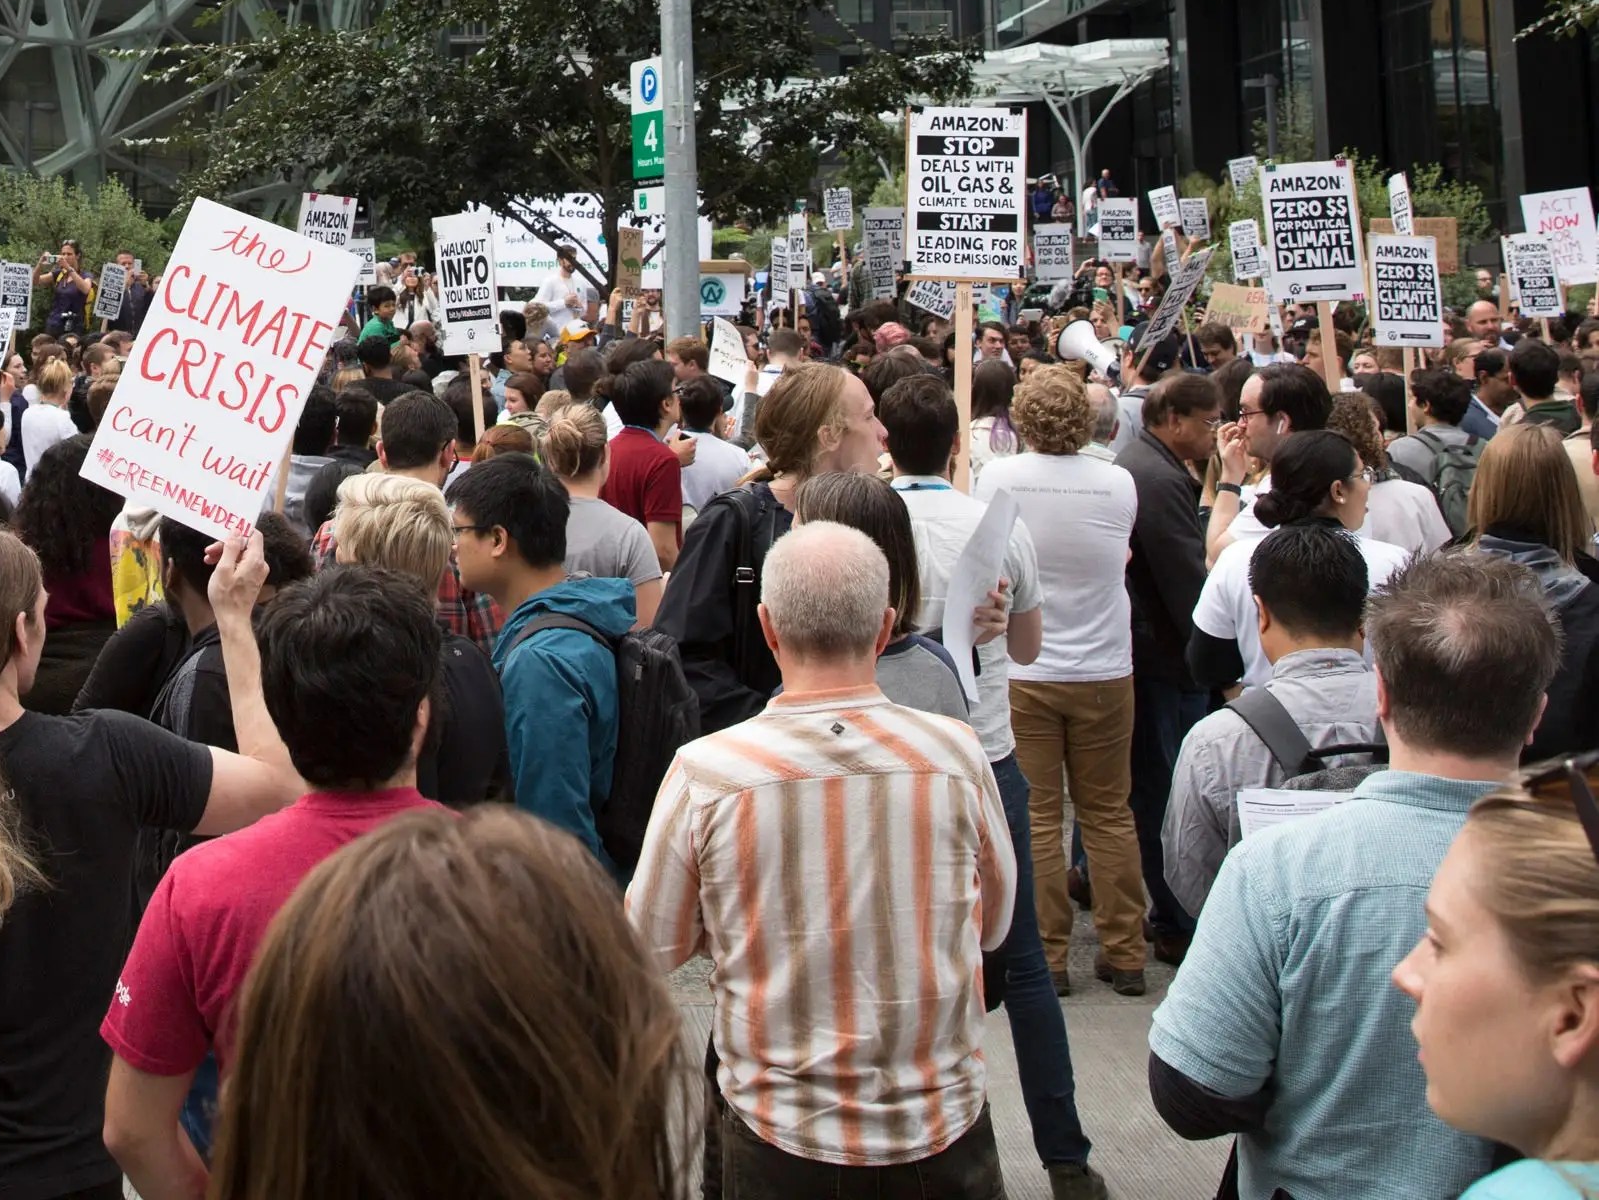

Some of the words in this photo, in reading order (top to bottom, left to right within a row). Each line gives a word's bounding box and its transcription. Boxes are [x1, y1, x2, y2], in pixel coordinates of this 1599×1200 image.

[644, 75, 655, 97] P
[930, 116, 1008, 131] AMAZON:
[644, 120, 658, 151] 4
[943, 137, 994, 155] STOP
[638, 158, 653, 168] Hours
[654, 157, 664, 165] Ma
[921, 159, 970, 172] DEALS
[976, 161, 1014, 173] WITH
[922, 176, 956, 195] OIL,
[958, 177, 994, 193] GAS
[999, 177, 1013, 194] &
[1270, 176, 1345, 192] AMAZON:
[919, 197, 967, 207] CLIMATE
[974, 198, 1015, 208] DENIAL
[1272, 200, 1322, 218] ZERO
[1326, 197, 1347, 217] $$
[1540, 197, 1576, 214] ACT
[867, 220, 880, 229] NO
[881, 220, 901, 229] AWS
[940, 214, 994, 230] START
[1274, 221, 1294, 231] FOR
[1295, 218, 1349, 230] POLITICAL
[1540, 213, 1579, 231] NOW
[325, 231, 346, 245] LEAD
[918, 236, 983, 251] LEADING
[991, 239, 1017, 250] FOR
[1050, 236, 1068, 244] AWS
[1276, 229, 1352, 249] CLIMATE
[1554, 230, 1572, 241] OR
[209, 225, 311, 274] the
[440, 239, 486, 257] WALKOUT
[1039, 248, 1053, 256] FOR
[1054, 248, 1068, 256] OIL
[917, 252, 950, 263] ZERO
[954, 253, 1017, 266] EMISSIONS
[1054, 257, 1069, 265] GAS
[1278, 247, 1355, 269] DENIAL
[441, 255, 489, 288] INFO
[1377, 265, 1414, 279] ZERO
[1417, 265, 1433, 280] $$
[1379, 280, 1393, 288] FOR
[1394, 281, 1434, 290] POLITICAL
[1524, 278, 1549, 287] ZERO
[6, 295, 24, 304] ZERO
[445, 289, 462, 304] YOU
[465, 287, 490, 301] NEED
[1379, 290, 1436, 304] CLIMATE
[164, 265, 334, 371] CLIMATE
[1381, 304, 1438, 320] DENIAL
[140, 327, 299, 434] CRISIS
[202, 446, 273, 492] wait
[97, 448, 252, 538] #GREENNEWDEAL
